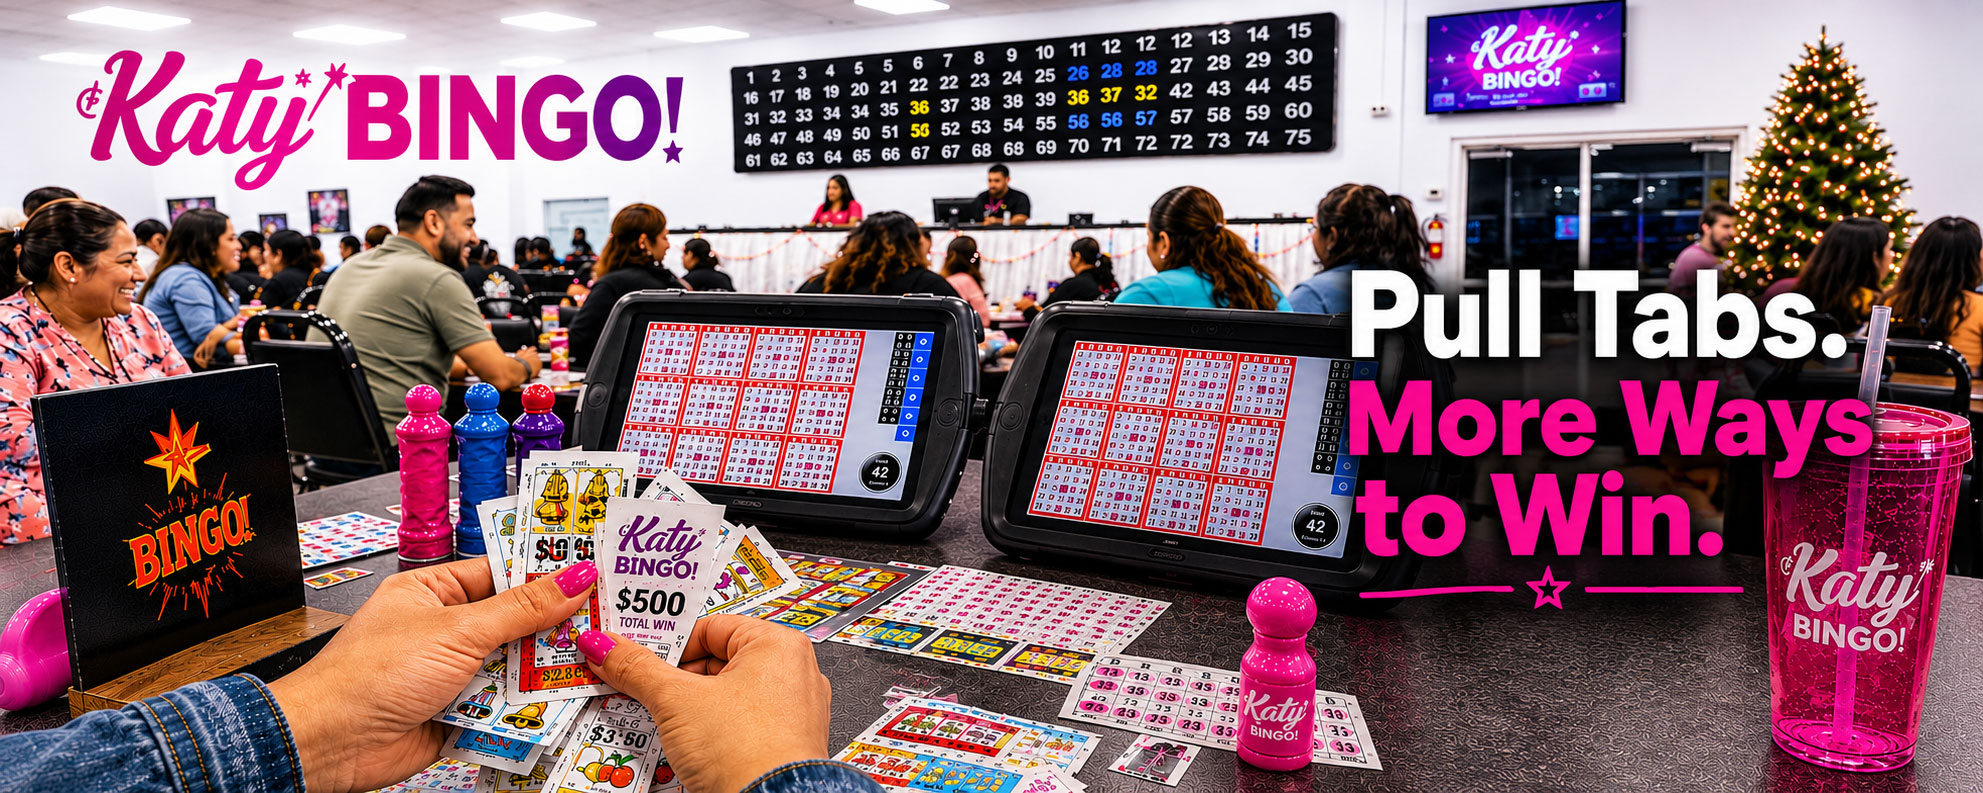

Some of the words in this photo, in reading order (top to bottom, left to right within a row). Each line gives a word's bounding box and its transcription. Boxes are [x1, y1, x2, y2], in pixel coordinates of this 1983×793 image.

[746, 71, 754, 85] 1
[771, 68, 781, 83] 2
[797, 66, 807, 80] 3
[824, 63, 836, 77] 4
[854, 60, 864, 76] 5
[883, 58, 894, 73] 5
[912, 55, 924, 71] 6
[942, 52, 954, 68] 7
[973, 50, 985, 65] 8
[1006, 47, 1018, 63] 9
[1035, 44, 1055, 60] 10
[1069, 41, 1086, 57] 11
[1101, 38, 1122, 55] 12
[1135, 35, 1157, 52] 12
[1170, 31, 1193, 49] 12
[1207, 28, 1231, 46] 13
[1246, 25, 1270, 43] 14
[1287, 21, 1312, 39] 15
[1473, 24, 1573, 71] Katy
[743, 90, 759, 105] 16
[768, 89, 785, 104] 17
[794, 86, 812, 101] 18
[822, 84, 840, 99] 19
[850, 81, 870, 97] 20
[879, 79, 897, 95] 21
[909, 77, 929, 93] 22
[939, 74, 959, 90] 22
[970, 72, 991, 88] 23
[1002, 70, 1023, 86] 24
[1034, 67, 1056, 84] 25
[1067, 64, 1090, 82] 26
[1100, 62, 1123, 80] 28
[1134, 59, 1158, 77] 28
[1169, 56, 1194, 74] 27
[1206, 54, 1232, 72] 28
[1245, 51, 1272, 69] 29
[1285, 47, 1313, 66] 30
[1482, 68, 1562, 90] BINGO!
[744, 111, 760, 126] 31
[769, 109, 787, 125] 32
[795, 108, 814, 123] 33
[823, 106, 841, 121] 34
[851, 104, 870, 119] 34
[879, 102, 899, 117] 35
[909, 99, 930, 116] 36
[940, 97, 960, 114] 37
[970, 95, 991, 111] 38
[1002, 93, 1024, 109] 38
[1035, 91, 1056, 107] 39
[1067, 88, 1090, 106] 36
[1100, 86, 1123, 104] 37
[1134, 83, 1158, 102] 32
[1168, 82, 1193, 99] 42
[1206, 80, 1231, 97] 43
[1244, 77, 1271, 95] 44
[1284, 74, 1313, 92] 45
[743, 132, 762, 147] 46
[769, 131, 788, 145] 47
[795, 129, 814, 144] 48
[823, 127, 842, 142] 49
[852, 126, 871, 141] 50
[881, 124, 899, 139] 51
[940, 121, 961, 137] 52
[971, 119, 992, 135] 53
[1003, 117, 1025, 133] 54
[1035, 115, 1057, 131] 55
[1135, 109, 1158, 127] 57
[1170, 108, 1194, 125] 57
[1206, 106, 1232, 123] 58
[1245, 104, 1271, 121] 59
[1284, 101, 1313, 119] 60
[745, 153, 761, 168] 61
[770, 152, 788, 167] 62
[796, 151, 815, 166] 63
[823, 149, 843, 164] 64
[852, 148, 872, 163] 65
[881, 146, 901, 162] 66
[910, 145, 930, 160] 67
[941, 144, 961, 159] 67
[971, 142, 992, 158] 68
[1003, 141, 1025, 157] 68
[1035, 139, 1057, 155] 69
[1068, 138, 1090, 154] 70
[1101, 136, 1121, 153] 71
[1135, 135, 1158, 151] 72
[1170, 133, 1194, 150] 72
[1207, 132, 1231, 149] 73
[1245, 130, 1270, 147] 74
[1284, 128, 1312, 146] 75
[871, 466, 889, 479] 42
[129, 496, 257, 589] BINGO!
[618, 515, 702, 561] Katy
[1306, 519, 1326, 534] 42
[614, 556, 699, 580] BINGO!
[1785, 541, 1920, 628] Katy
[615, 586, 686, 617] $500
[619, 616, 650, 630] TOTAL
[653, 618, 676, 632] WIN
[1793, 613, 1907, 653] BINGO!
[1243, 690, 1308, 731] Katy
[1250, 724, 1299, 741] BINGO!
